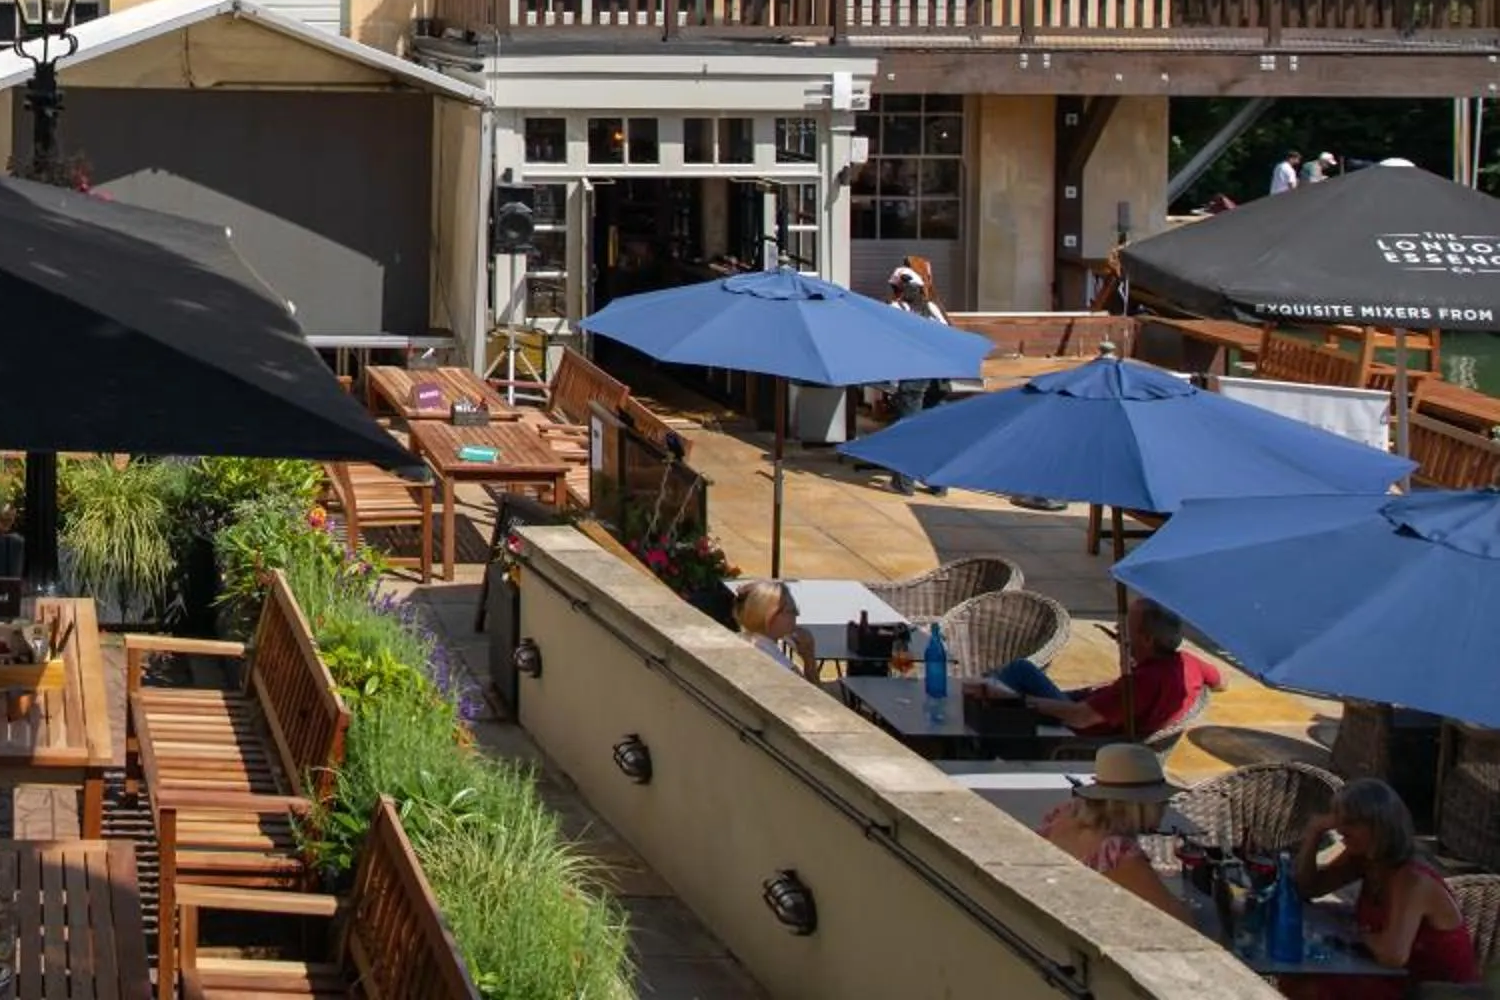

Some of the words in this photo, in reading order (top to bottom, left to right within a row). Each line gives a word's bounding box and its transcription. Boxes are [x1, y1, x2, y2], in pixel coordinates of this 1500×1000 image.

[1422, 231, 1457, 241] THE
[1376, 239, 1500, 253] LONDO
[1255, 303, 1355, 317] EXQUISITE
[1361, 305, 1432, 319] MIXERS
[1438, 307, 1493, 321] FROM
